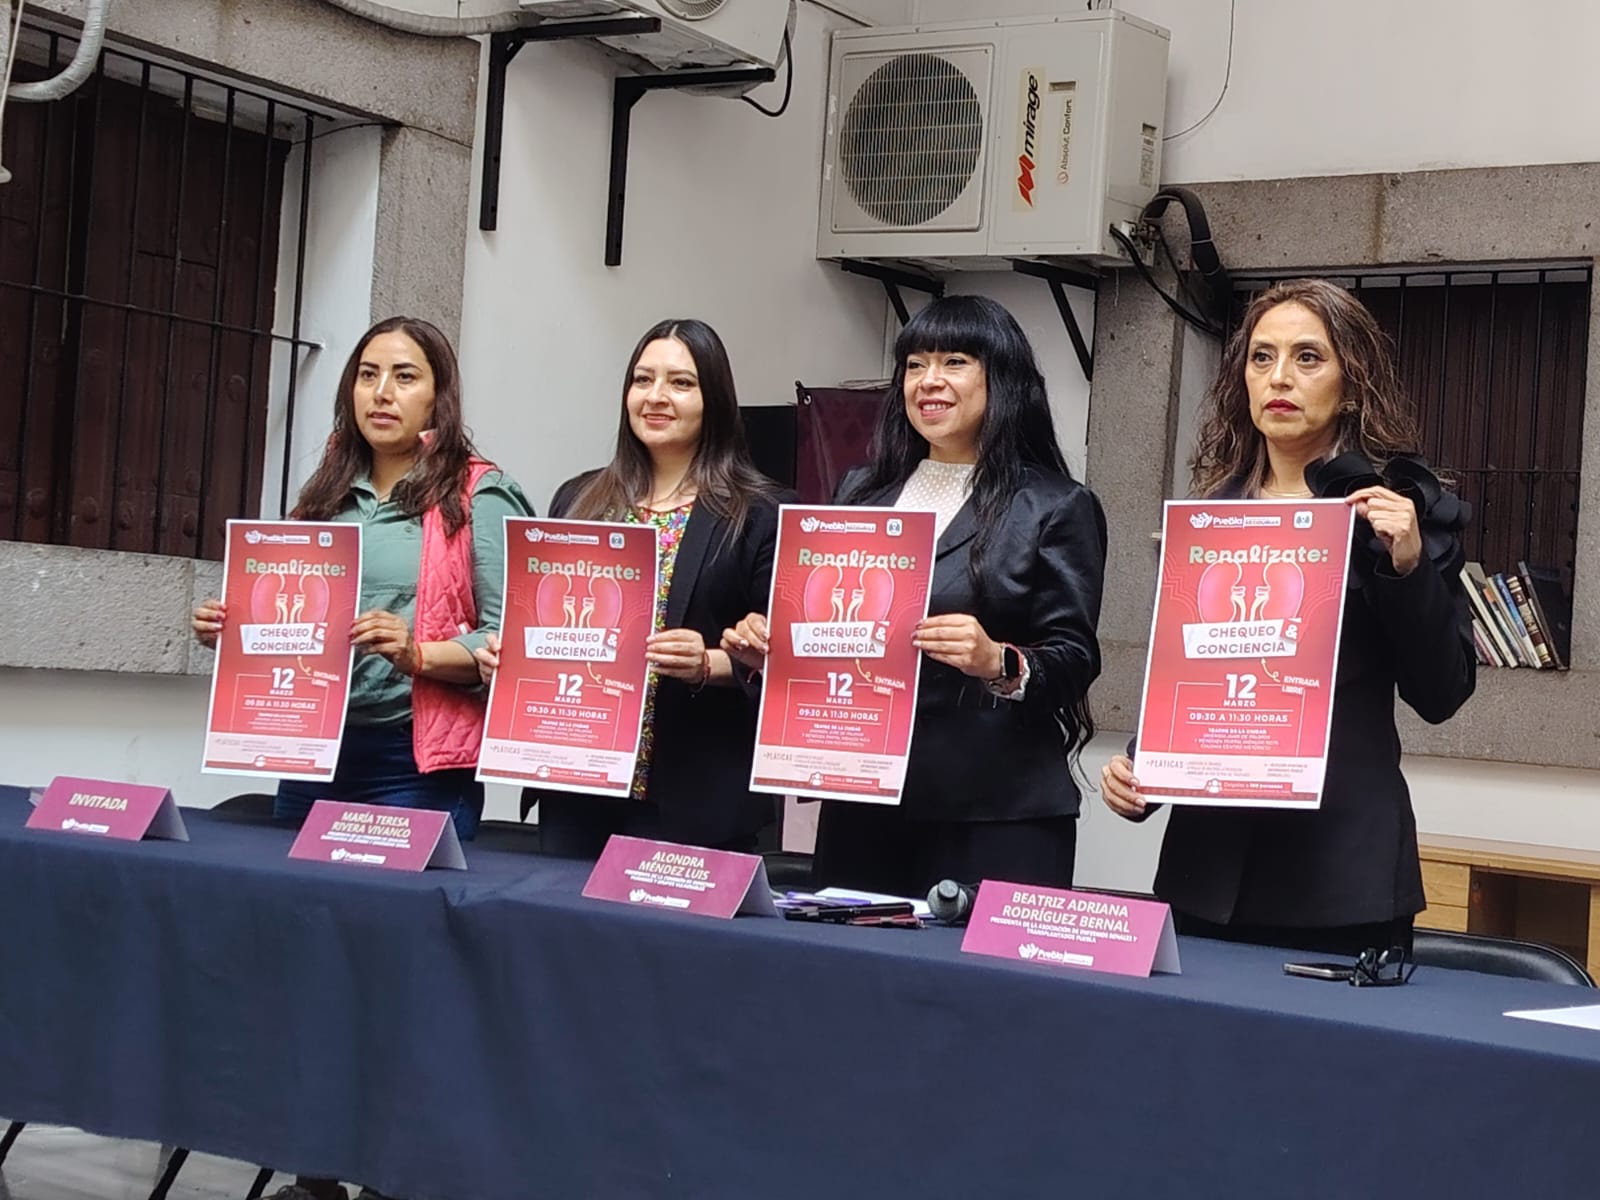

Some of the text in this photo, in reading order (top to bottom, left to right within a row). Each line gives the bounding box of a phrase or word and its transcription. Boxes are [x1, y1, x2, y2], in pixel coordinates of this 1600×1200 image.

[1023, 74, 1040, 158] mirage
[798, 548, 916, 570] Renalízate:
[1189, 544, 1329, 564] Renalízate:
[245, 557, 347, 577] Renalízate:
[527, 556, 641, 581] Renalízate:
[259, 626, 325, 641] CHEQUEO &
[545, 631, 618, 648] CHEQUEO &
[812, 626, 886, 641] CHEQUEO &
[1208, 624, 1298, 640] CHEQUEO &
[250, 641, 317, 651] CONCIENCIA
[535, 645, 608, 658] CONCIENCIA
[802, 642, 877, 654] CONCIENCIA
[1196, 641, 1286, 655] CONCIENCIA
[272, 667, 296, 689] 12
[558, 672, 583, 697] 12
[827, 671, 853, 697] 12
[874, 675, 906, 691] ENTRADA
[1226, 673, 1257, 699] 12
[1283, 675, 1320, 688] ENTRADA
[554, 695, 582, 704] MARZO
[825, 697, 853, 705] MARZO
[1223, 699, 1257, 707] MARZO
[550, 707, 557, 715] A
[578, 711, 608, 720] HORAS
[822, 710, 829, 718] A
[850, 711, 879, 721] HORAS
[1218, 713, 1226, 721] A
[1254, 714, 1288, 723] HORAS
[68, 792, 129, 811] INVITADA
[341, 810, 410, 827] MARÍA TERESA
[331, 821, 412, 839] RIVERA VIVANCO
[651, 851, 705, 868] ALONDRA
[638, 860, 711, 881] MÉNDEZ LUIS
[1012, 890, 1129, 918] BEATRIZ ADRIANA
[1002, 904, 1130, 933] RODRÍGUEZ BERNAL
